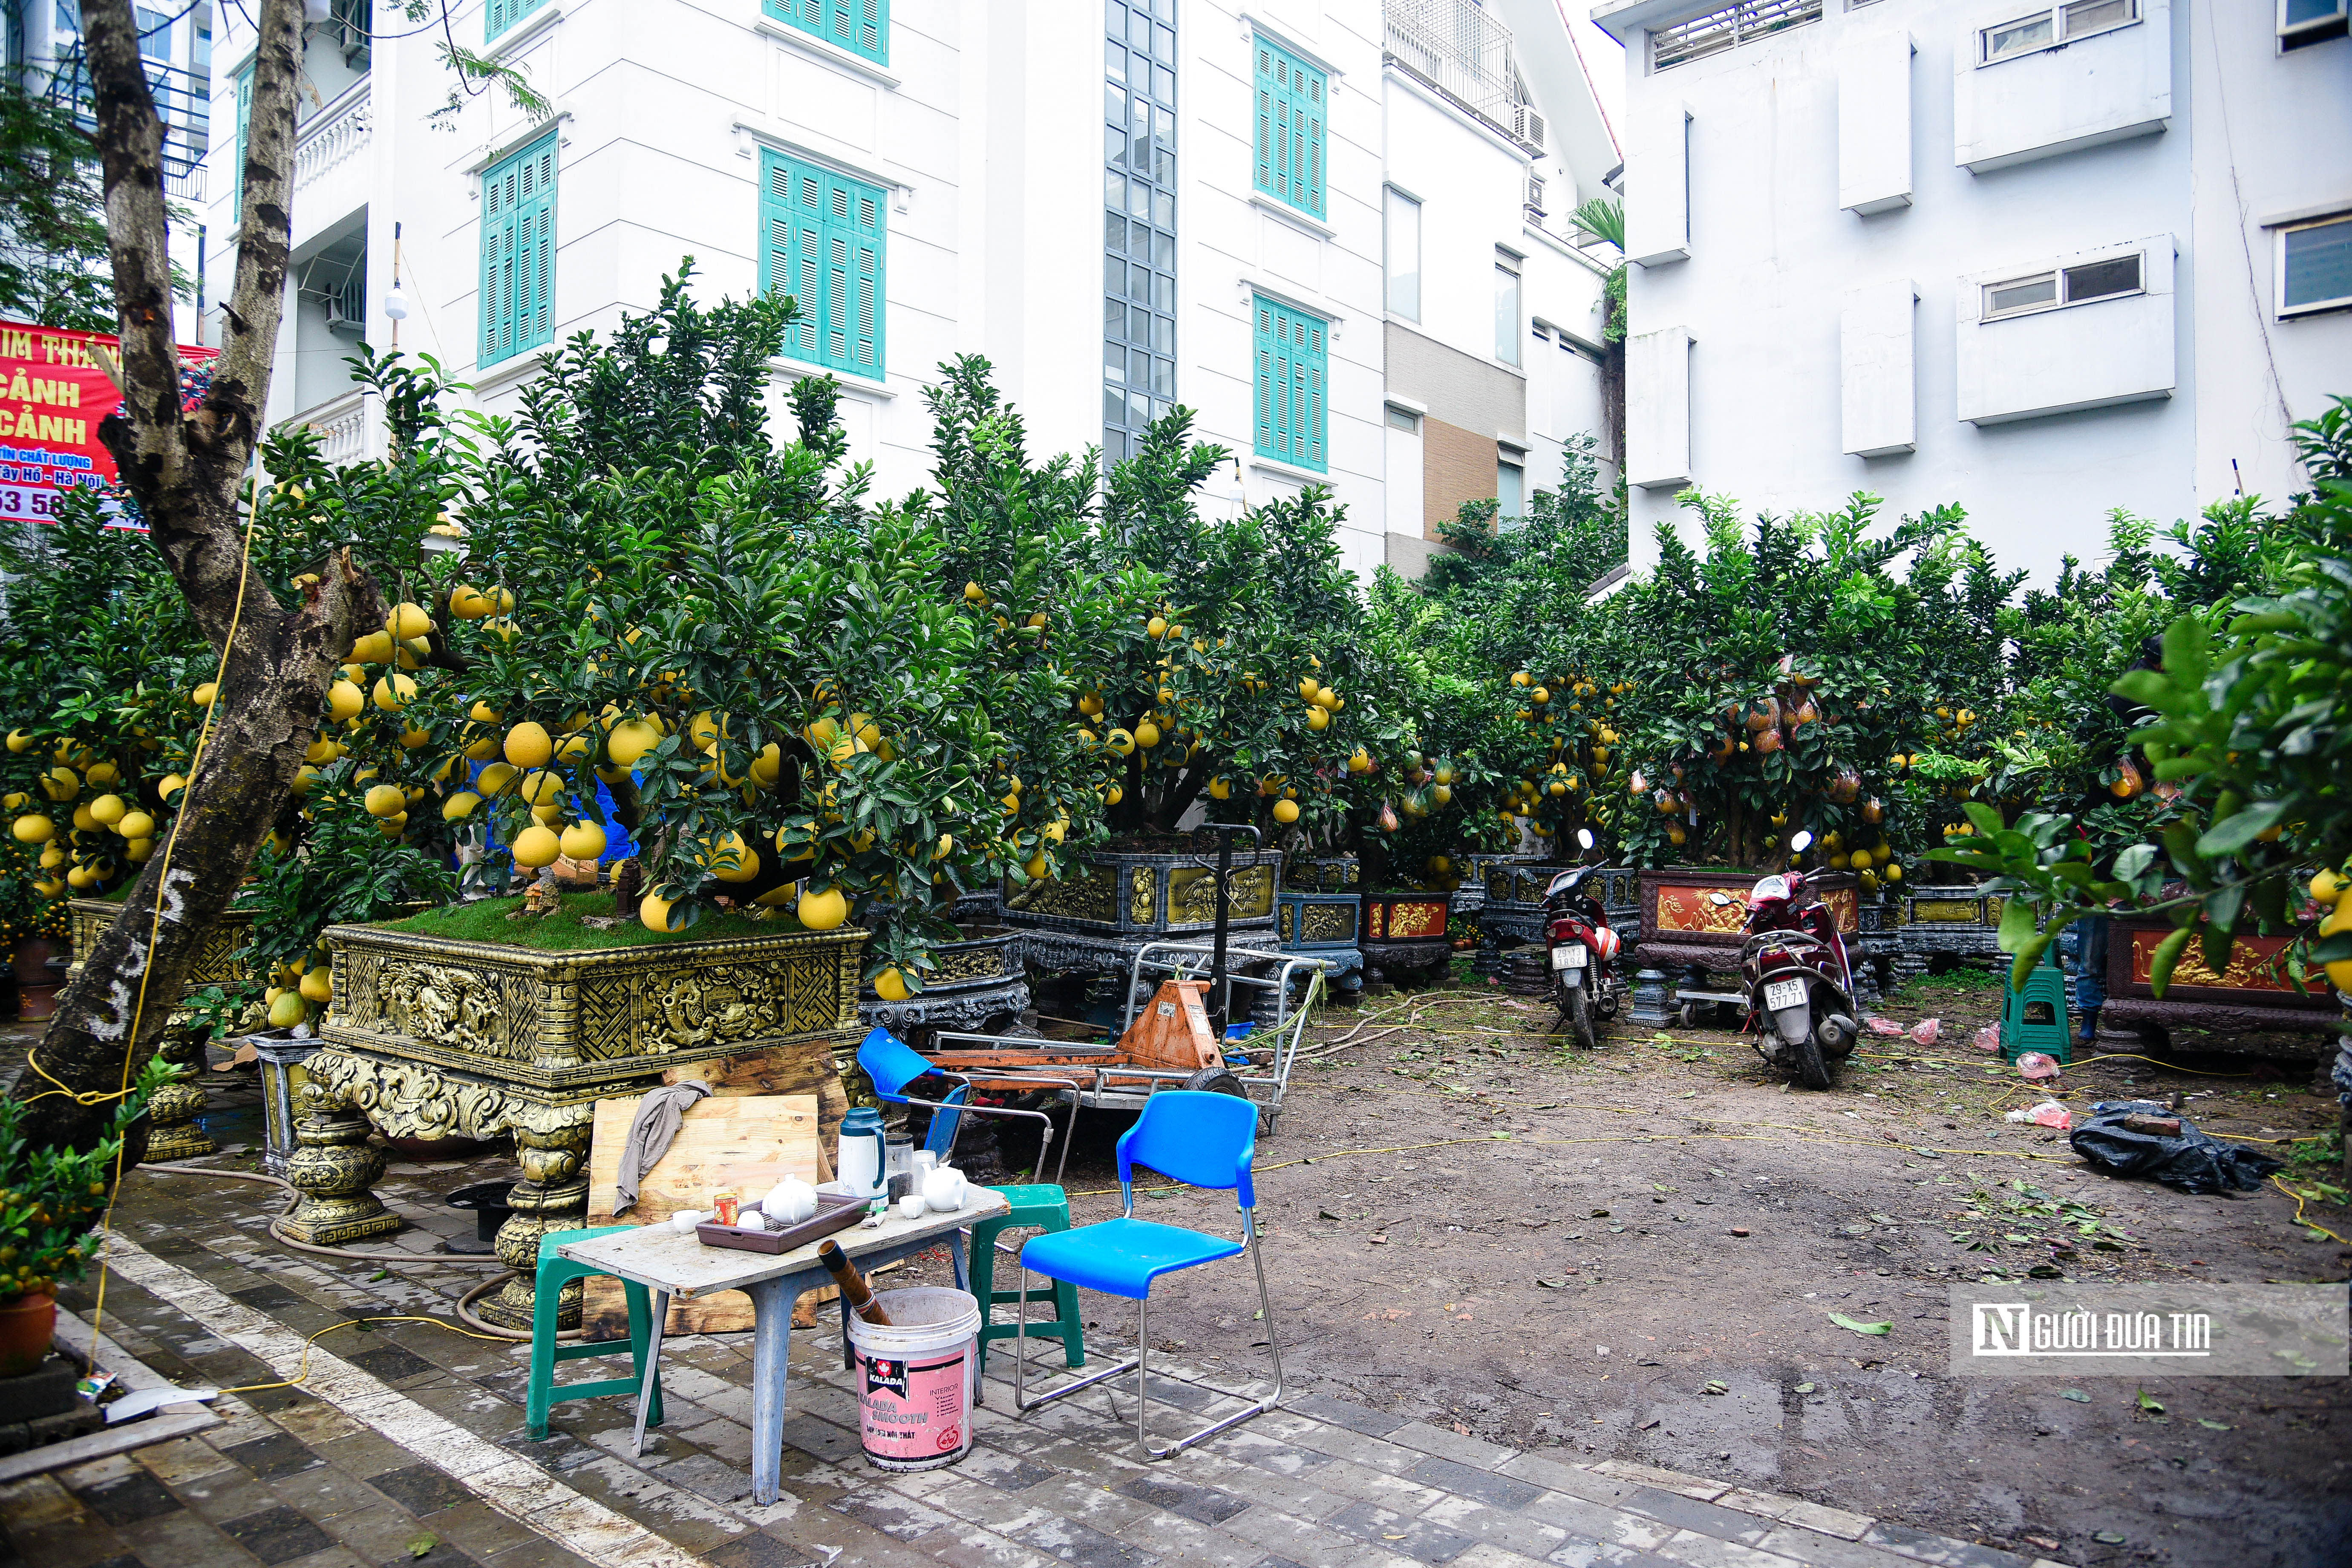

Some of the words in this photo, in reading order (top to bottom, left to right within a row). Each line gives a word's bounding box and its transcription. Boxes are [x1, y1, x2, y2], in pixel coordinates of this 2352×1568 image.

[0, 329, 33, 361] IM
[42, 335, 124, 373] THÁN
[0, 404, 86, 445] CẢNH
[19, 447, 50, 465] CHẤT
[51, 453, 92, 470] LƯỢNG
[0, 465, 20, 482] ây
[22, 466, 43, 483] Hồ
[54, 470, 74, 487] Hà
[0, 490, 21, 513] 3
[1770, 980, 1799, 996] 29-X5
[1770, 991, 1804, 1009] 577.71
[869, 1374, 903, 1386] KALADA
[929, 1383, 959, 1396] INTERIOR
[859, 1392, 897, 1413] KALADA
[872, 1409, 929, 1424] SMOOTH
